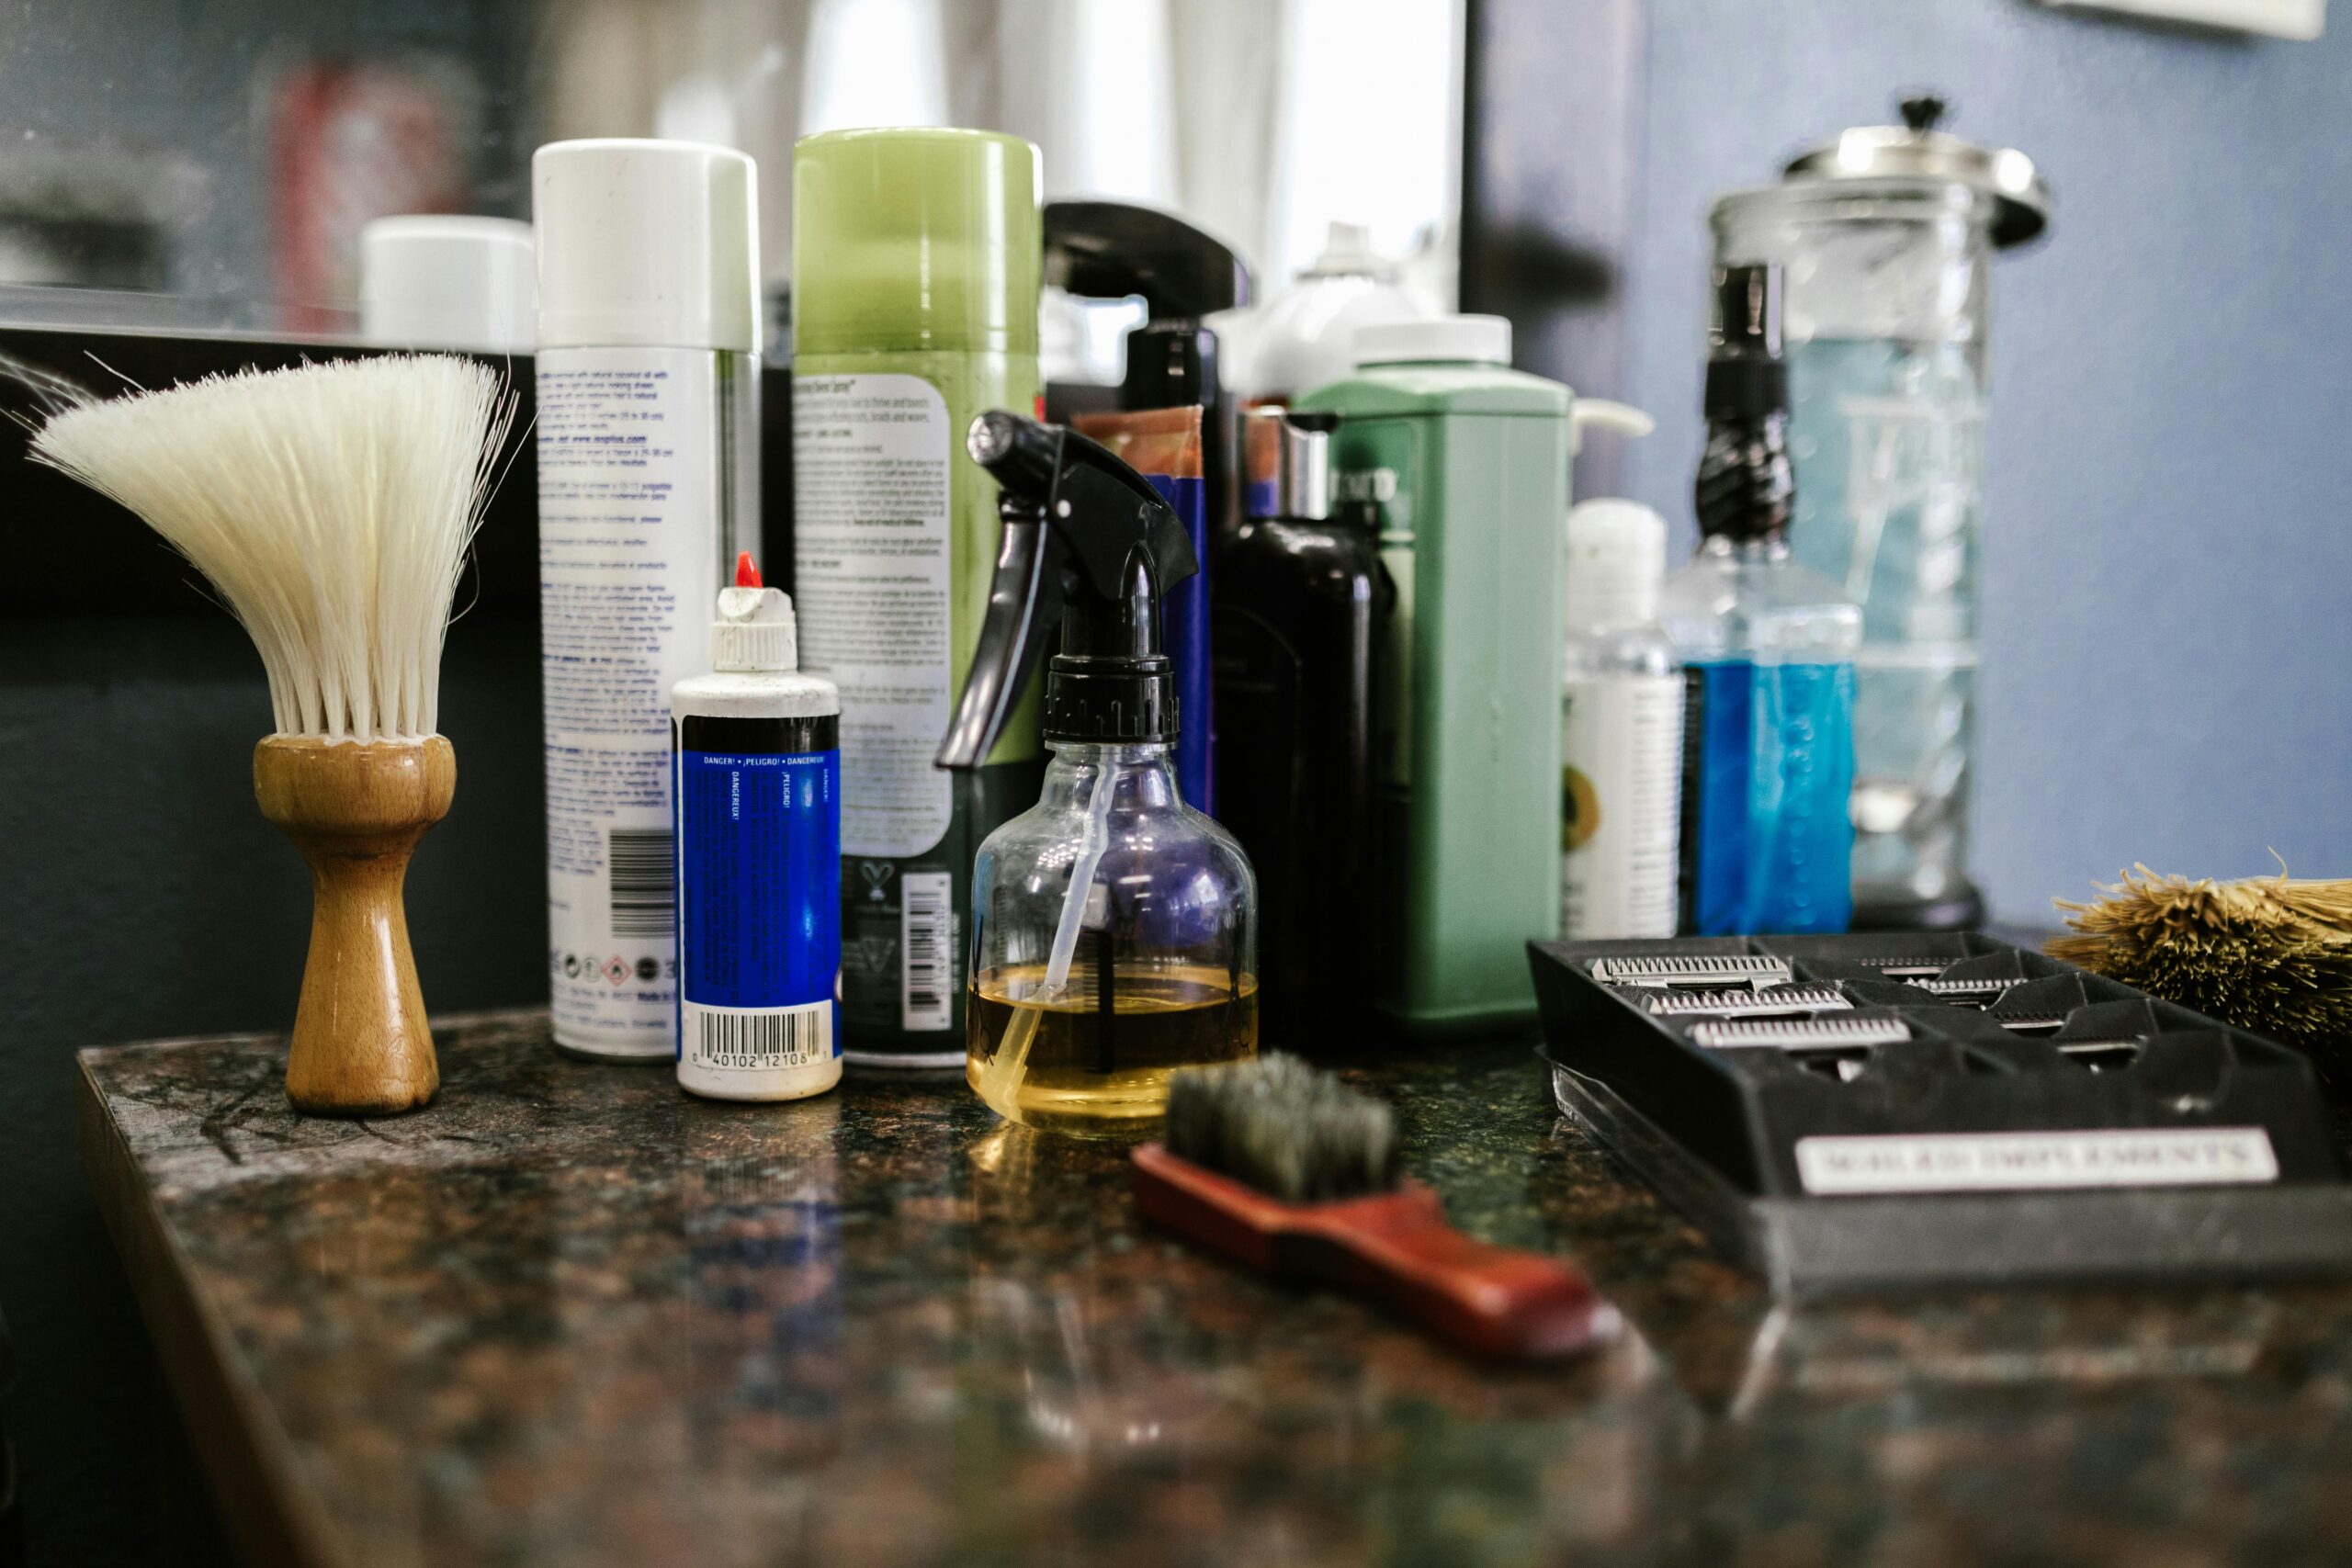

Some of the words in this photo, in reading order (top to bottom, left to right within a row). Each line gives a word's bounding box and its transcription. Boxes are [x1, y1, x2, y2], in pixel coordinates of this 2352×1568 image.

[704, 756, 736, 765] DANGER!
[731, 771, 741, 820] DANGEREUX!
[712, 1055, 757, 1067] 40102
[765, 1053, 808, 1066] 12108
